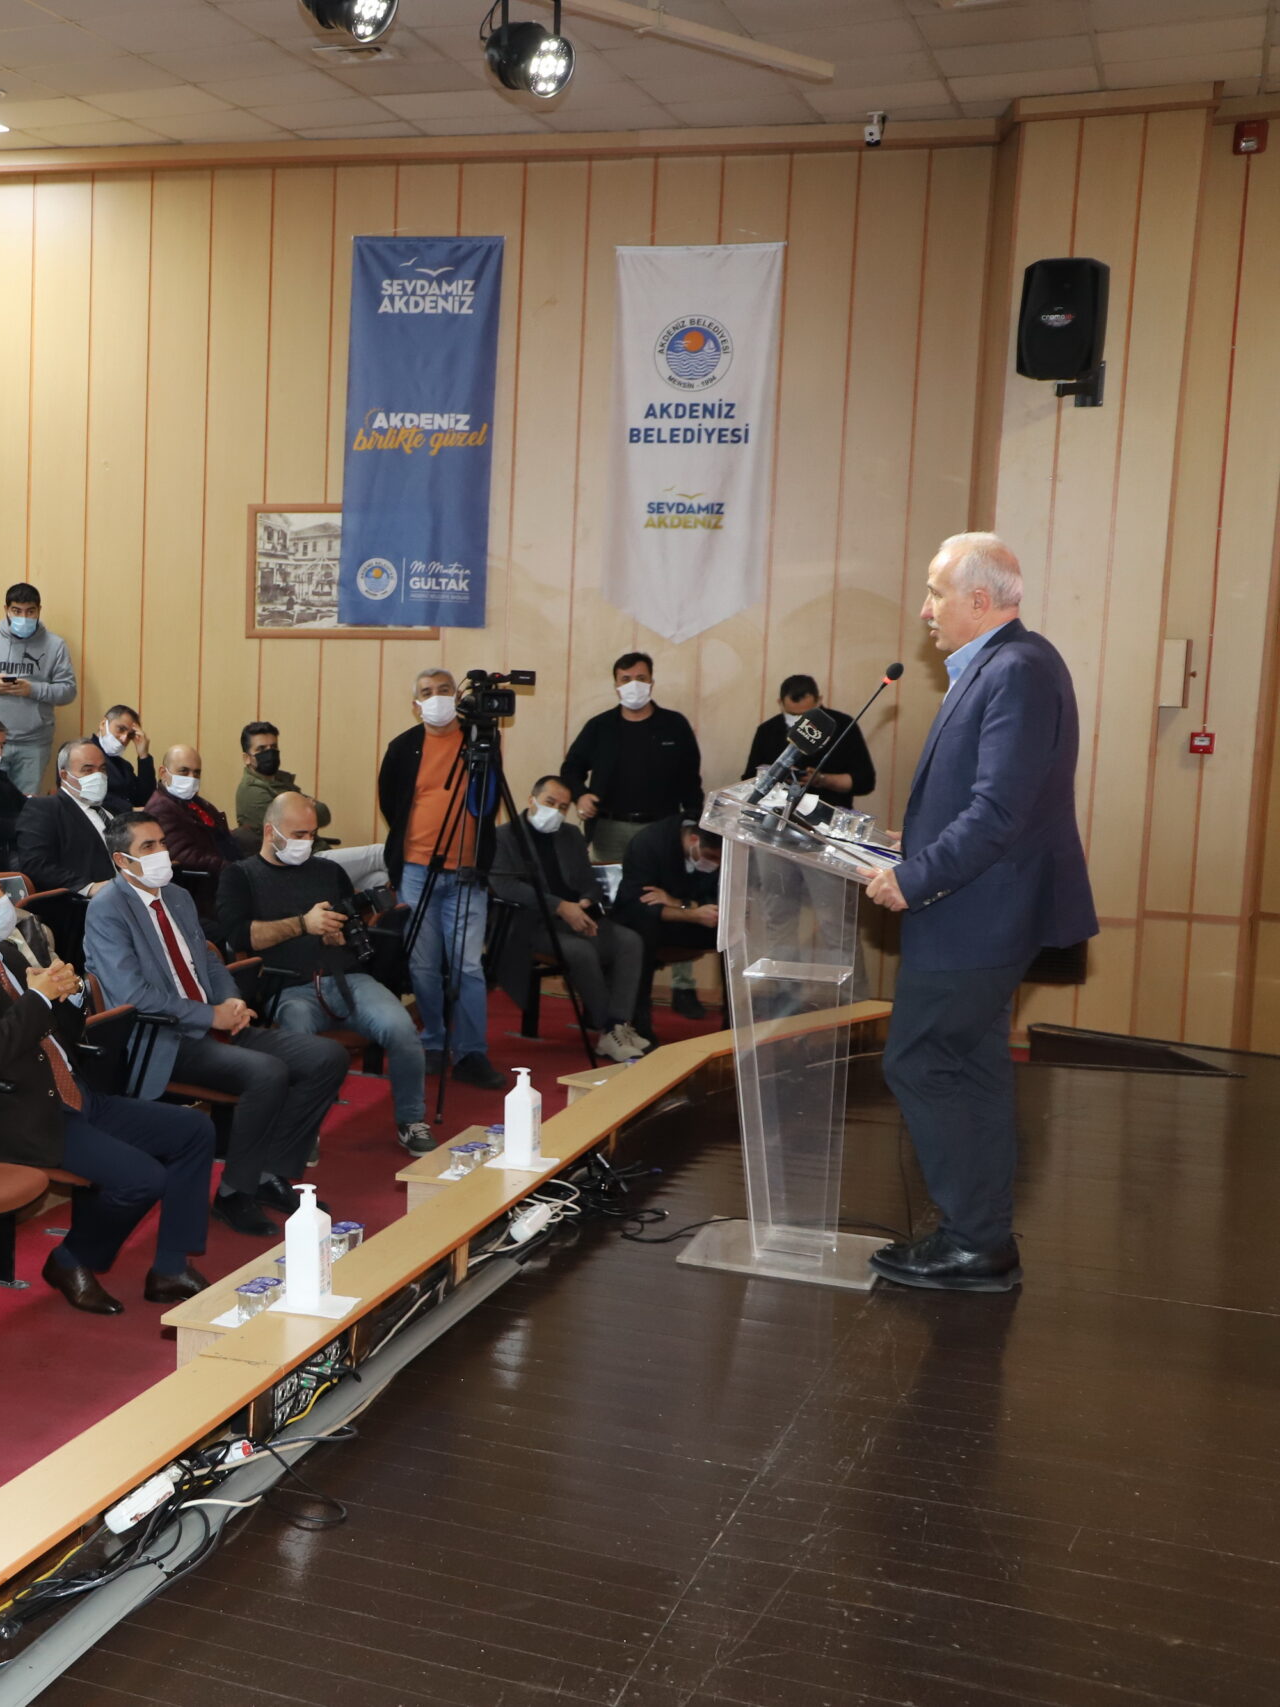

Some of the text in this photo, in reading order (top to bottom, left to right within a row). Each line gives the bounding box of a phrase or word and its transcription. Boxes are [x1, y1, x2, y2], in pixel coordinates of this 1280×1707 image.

[381, 279, 476, 295] SEVDAMIZ
[658, 318, 730, 354] AKDENİZ BELEDİYESİ
[701, 375, 717, 387] 1994
[643, 398, 736, 419] AKDENİZ
[352, 422, 488, 456] birlikte güzel
[629, 423, 749, 444] BELEDİYESİ
[646, 502, 725, 515] SEVDAMIZ
